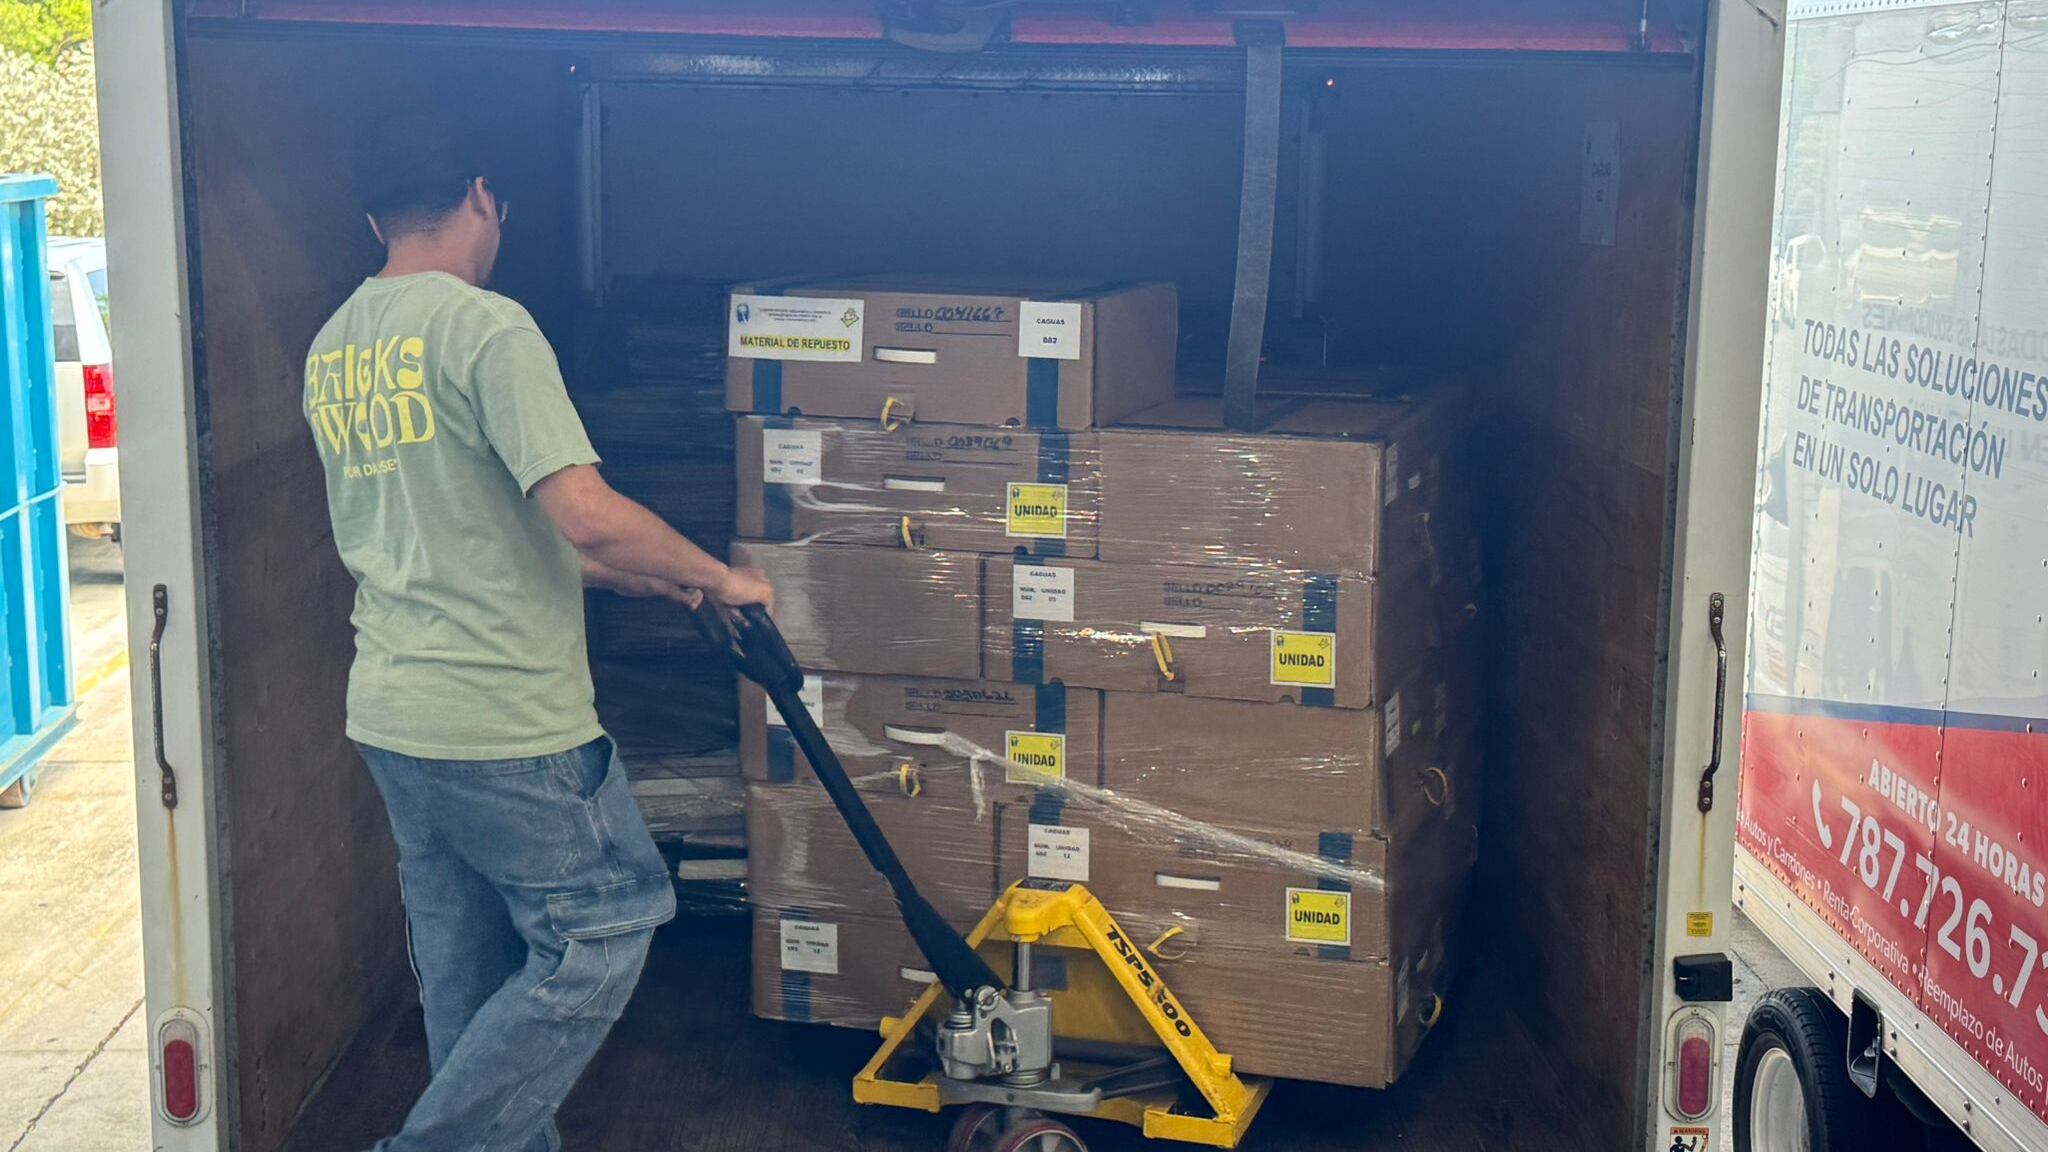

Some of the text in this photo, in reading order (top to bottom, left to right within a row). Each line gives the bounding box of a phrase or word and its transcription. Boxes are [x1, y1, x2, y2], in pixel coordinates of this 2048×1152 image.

[740, 335, 851, 351] MATERIAL DE REPUESTO
[1036, 318, 1066, 326] CAGUAS
[1803, 318, 2048, 422] TODAS LAS SOLUCIONES
[1797, 374, 1822, 416] DE
[1825, 382, 2006, 480] TRANSPORTACIÓN
[1014, 504, 1058, 518] UNIDAD
[1793, 431, 1977, 539] EN UN SOLO LUGAR
[1278, 652, 1325, 668] UNIDAD
[1013, 752, 1056, 767] UNIDAD
[1867, 759, 2047, 907] ABIERTO 24 HORAS
[1294, 910, 1341, 926] UNIDAD
[1840, 795, 2048, 1037] 787.726.7
[1743, 816, 1767, 847] Autos
[1766, 833, 1774, 856] y
[1773, 837, 1816, 890] Camiones
[1823, 880, 1851, 921] Renta
[1850, 905, 1910, 974] Corporativa
[1918, 966, 1983, 1041] Reemplazo
[1985, 1024, 2004, 1057] de
[2003, 1040, 2044, 1093] Autos
